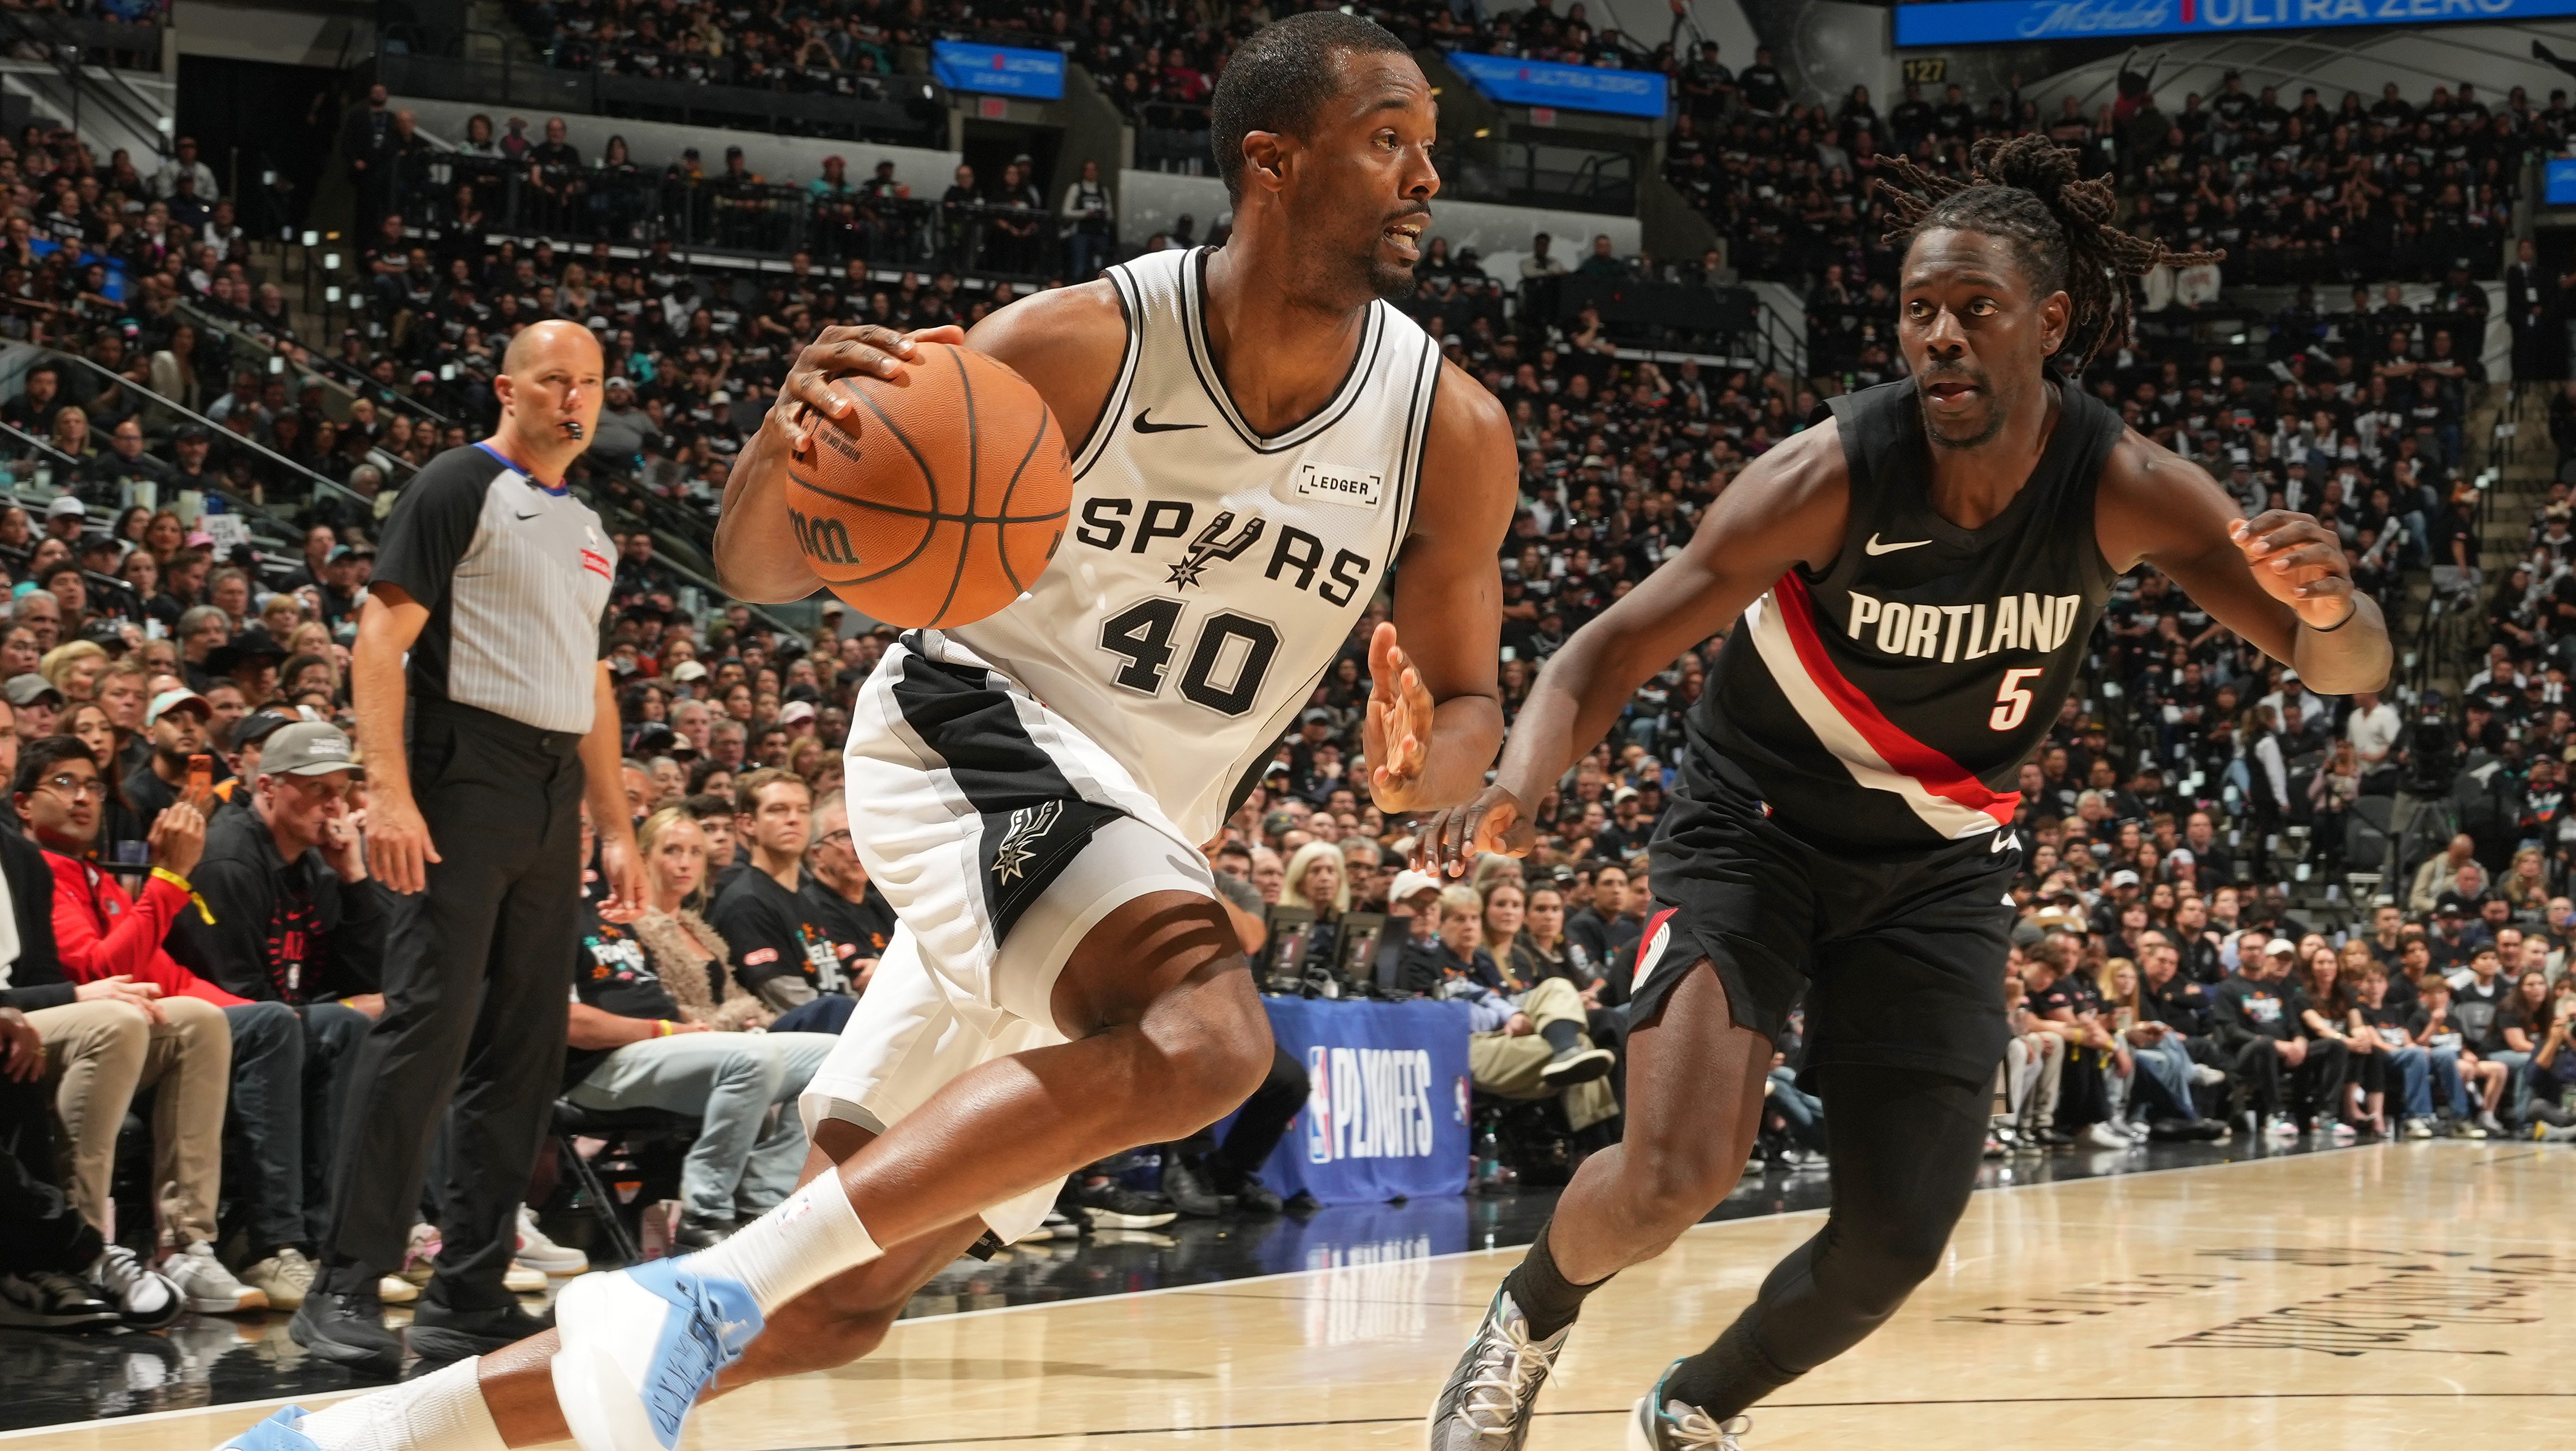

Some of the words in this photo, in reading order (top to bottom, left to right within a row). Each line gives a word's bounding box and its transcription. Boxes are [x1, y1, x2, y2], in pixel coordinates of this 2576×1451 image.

[1907, 60, 1945, 82] 127
[1310, 475, 1369, 496] LEDGER
[1075, 497, 1371, 608] SPURS
[1095, 594, 1285, 720] 40
[1846, 589, 2081, 663] PORTLAND
[1988, 667, 2044, 732] 5
